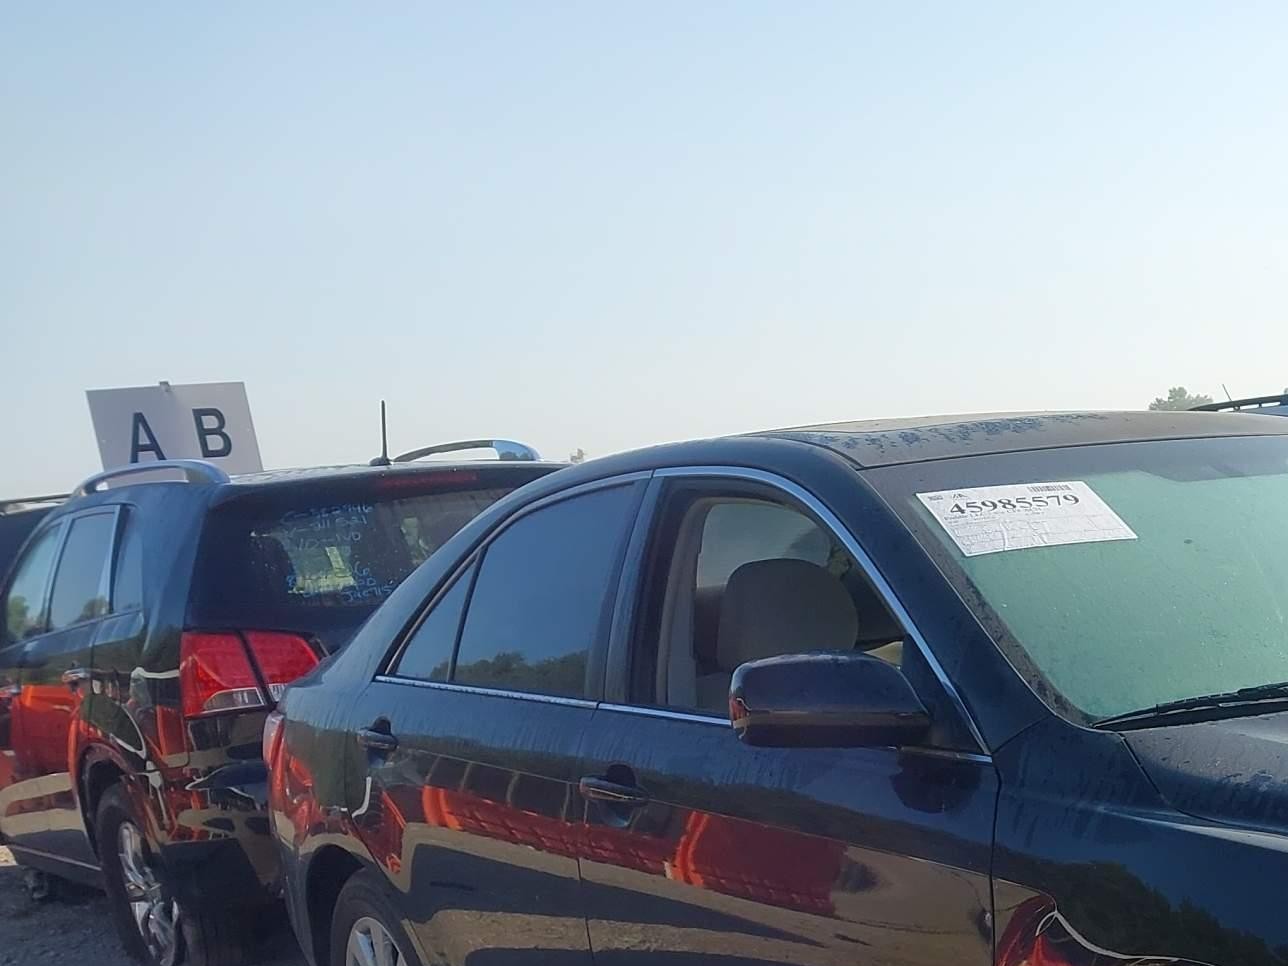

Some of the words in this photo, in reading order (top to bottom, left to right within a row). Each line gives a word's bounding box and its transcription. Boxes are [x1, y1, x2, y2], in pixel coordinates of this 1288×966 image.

[130, 411, 167, 463] A
[192, 407, 232, 458] B
[950, 494, 1080, 515] 45985579
